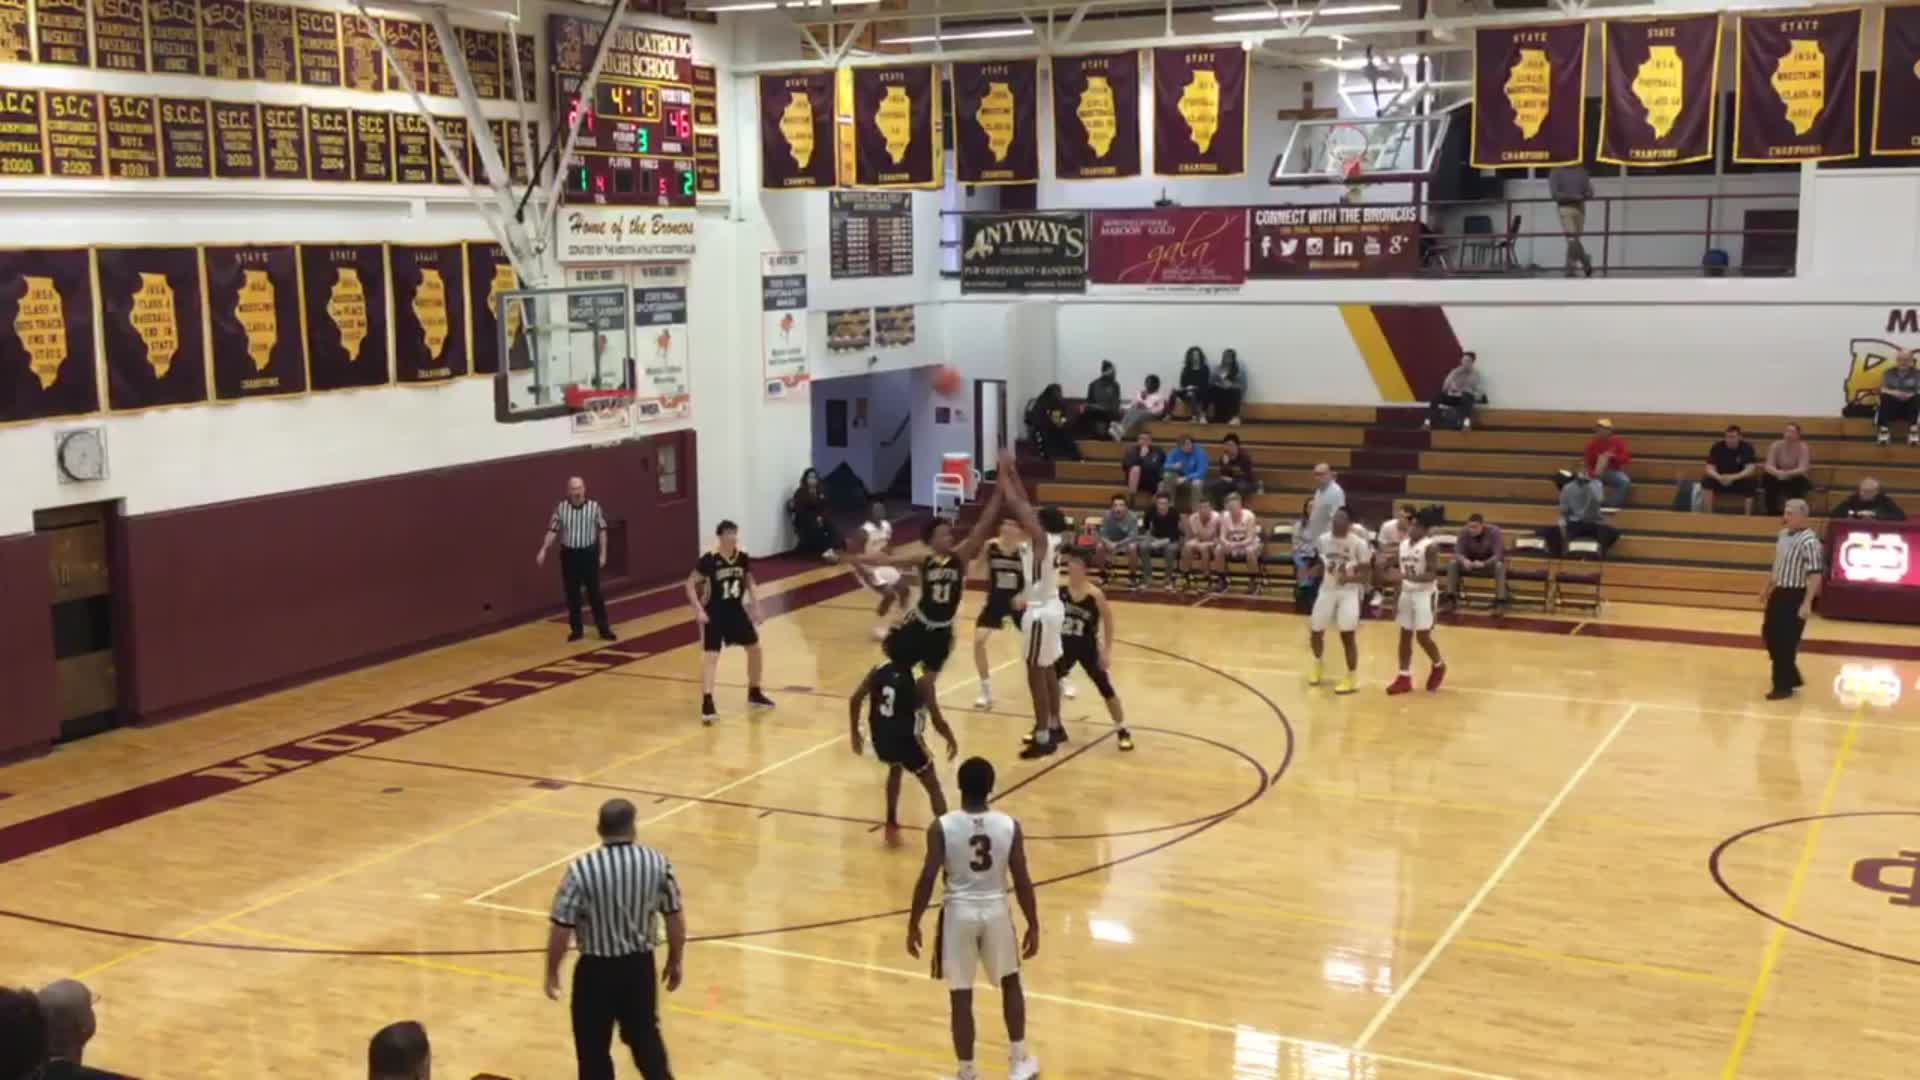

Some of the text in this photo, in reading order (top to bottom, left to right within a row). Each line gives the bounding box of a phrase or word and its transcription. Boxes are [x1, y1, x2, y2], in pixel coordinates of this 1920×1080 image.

[1513, 32, 1548, 44] STATE
[1647, 26, 1677, 38] STATE
[1780, 19, 1820, 33] STATE
[635, 33, 691, 62] CATHOLIC
[1185, 54, 1216, 65] STATE
[632, 59, 678, 84] SCHOOL
[611, 86, 657, 119] 4:15
[670, 108, 690, 139] 46
[637, 127, 648, 153] 3
[682, 170, 692, 197] 2
[568, 212, 694, 243] Home of the Broncos
[1256, 206, 1417, 225] CONNECT WITH THE BRONCOS
[965, 217, 1084, 265] ANYWAY'S
[722, 579, 741, 600] 14
[192, 646, 652, 785] MONTINI
[879, 686, 896, 718] 3
[968, 833, 993, 873] 3
